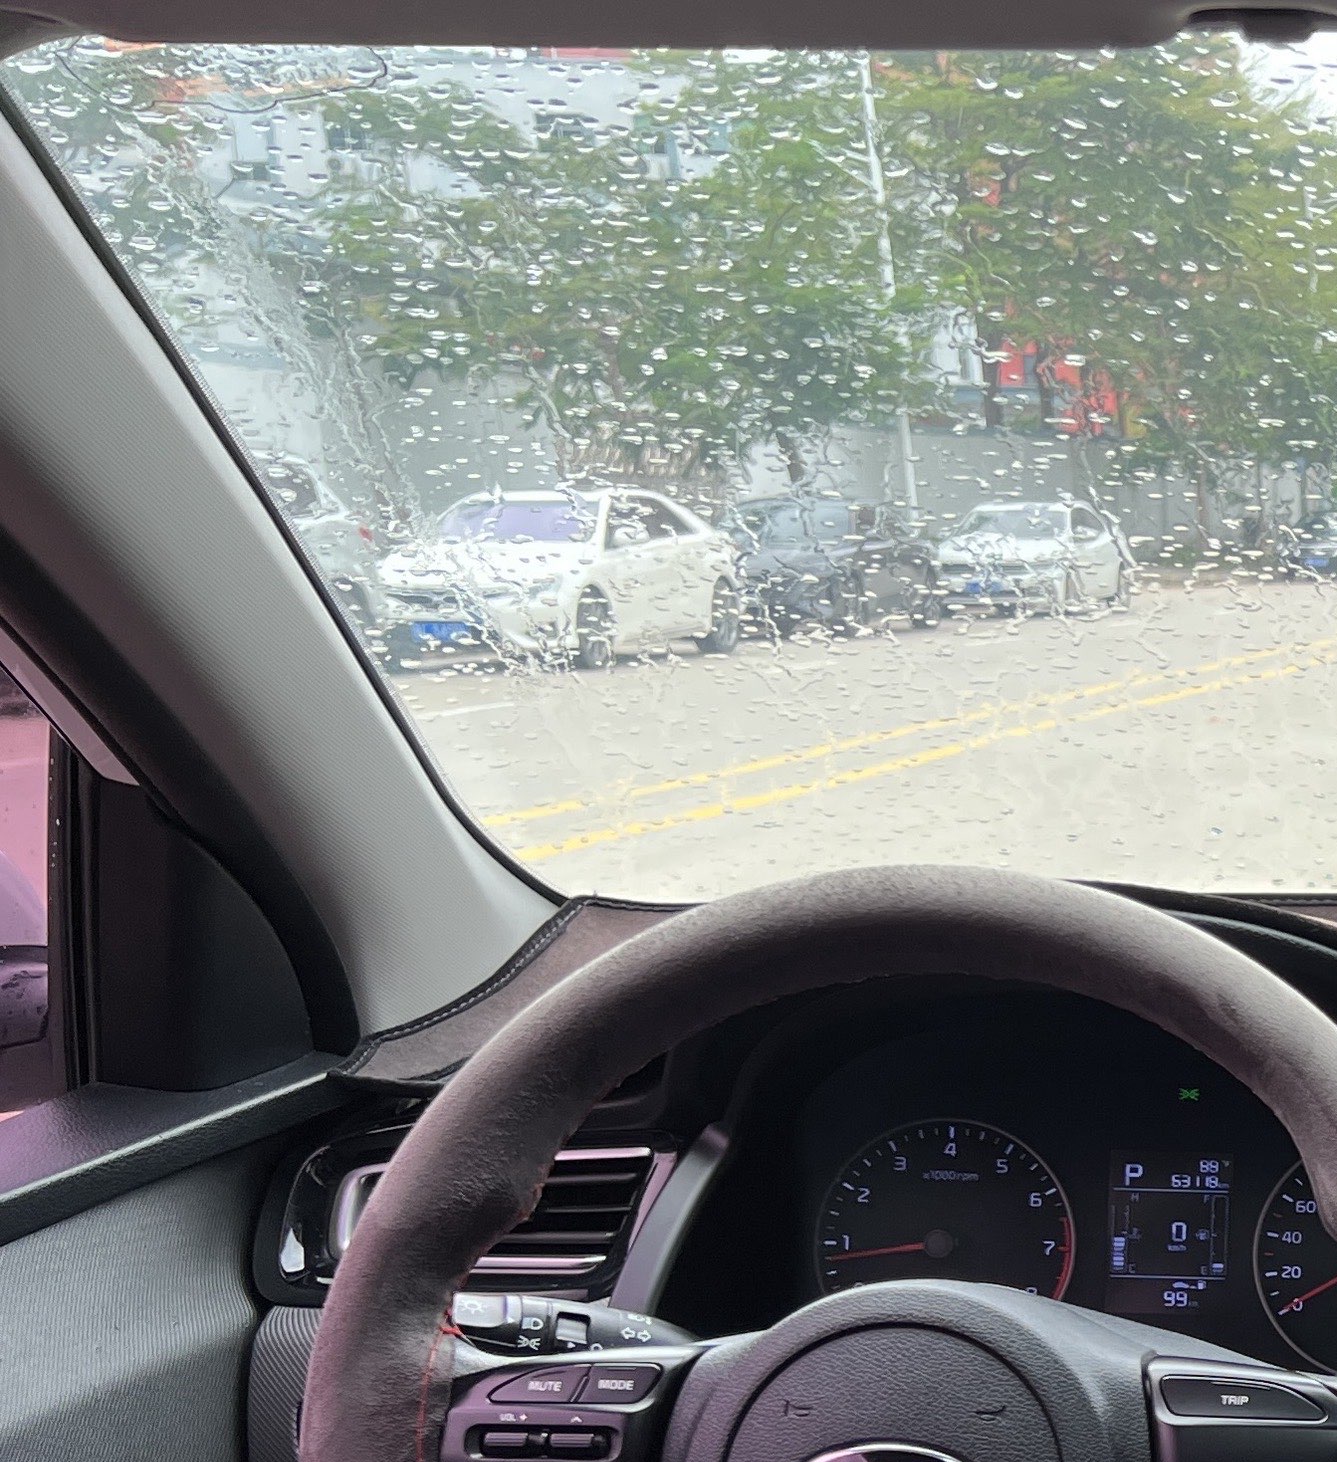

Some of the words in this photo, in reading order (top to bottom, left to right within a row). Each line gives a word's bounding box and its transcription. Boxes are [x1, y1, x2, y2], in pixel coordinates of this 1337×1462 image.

[944, 1143, 957, 1157] 4
[894, 1157, 907, 1171] 3
[996, 1159, 1008, 1173] 5
[1125, 1163, 1144, 1187] P
[858, 1187, 871, 1203] 2
[1030, 1192, 1042, 1207] 6
[1295, 1200, 1317, 1214] 60
[1171, 1221, 1188, 1243] 0
[1281, 1231, 1303, 1244] 40
[843, 1235, 850, 1250] 1
[1043, 1240, 1056, 1257] 7
[1281, 1265, 1302, 1279] 20
[1163, 1290, 1189, 1308] 99
[528, 1380, 562, 1392] MUTE
[598, 1379, 635, 1391] MODE
[1220, 1394, 1250, 1407] TRIP
